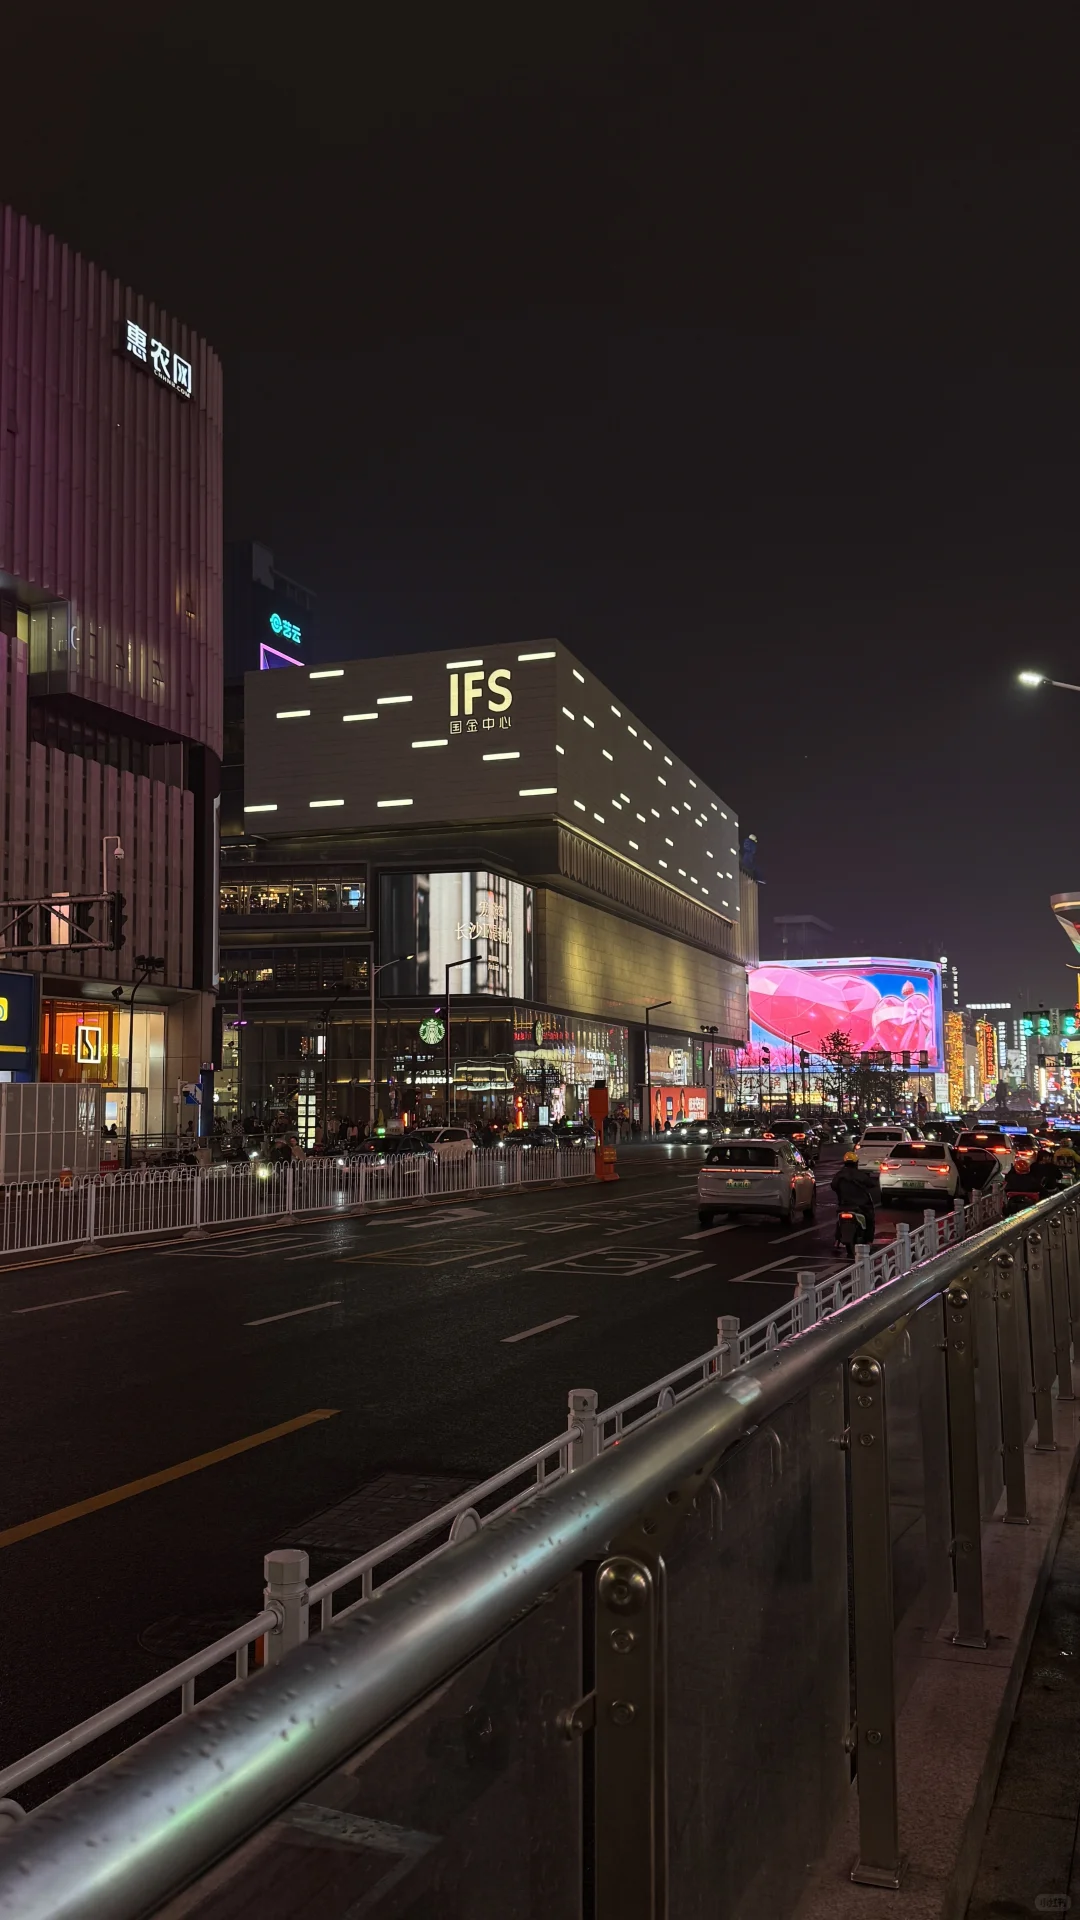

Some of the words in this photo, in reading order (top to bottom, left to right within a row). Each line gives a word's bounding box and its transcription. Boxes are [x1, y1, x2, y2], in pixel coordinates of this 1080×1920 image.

[126, 319, 192, 394] 惠农网
[450, 668, 513, 717] IFS
[449, 716, 512, 735] 国金中心
